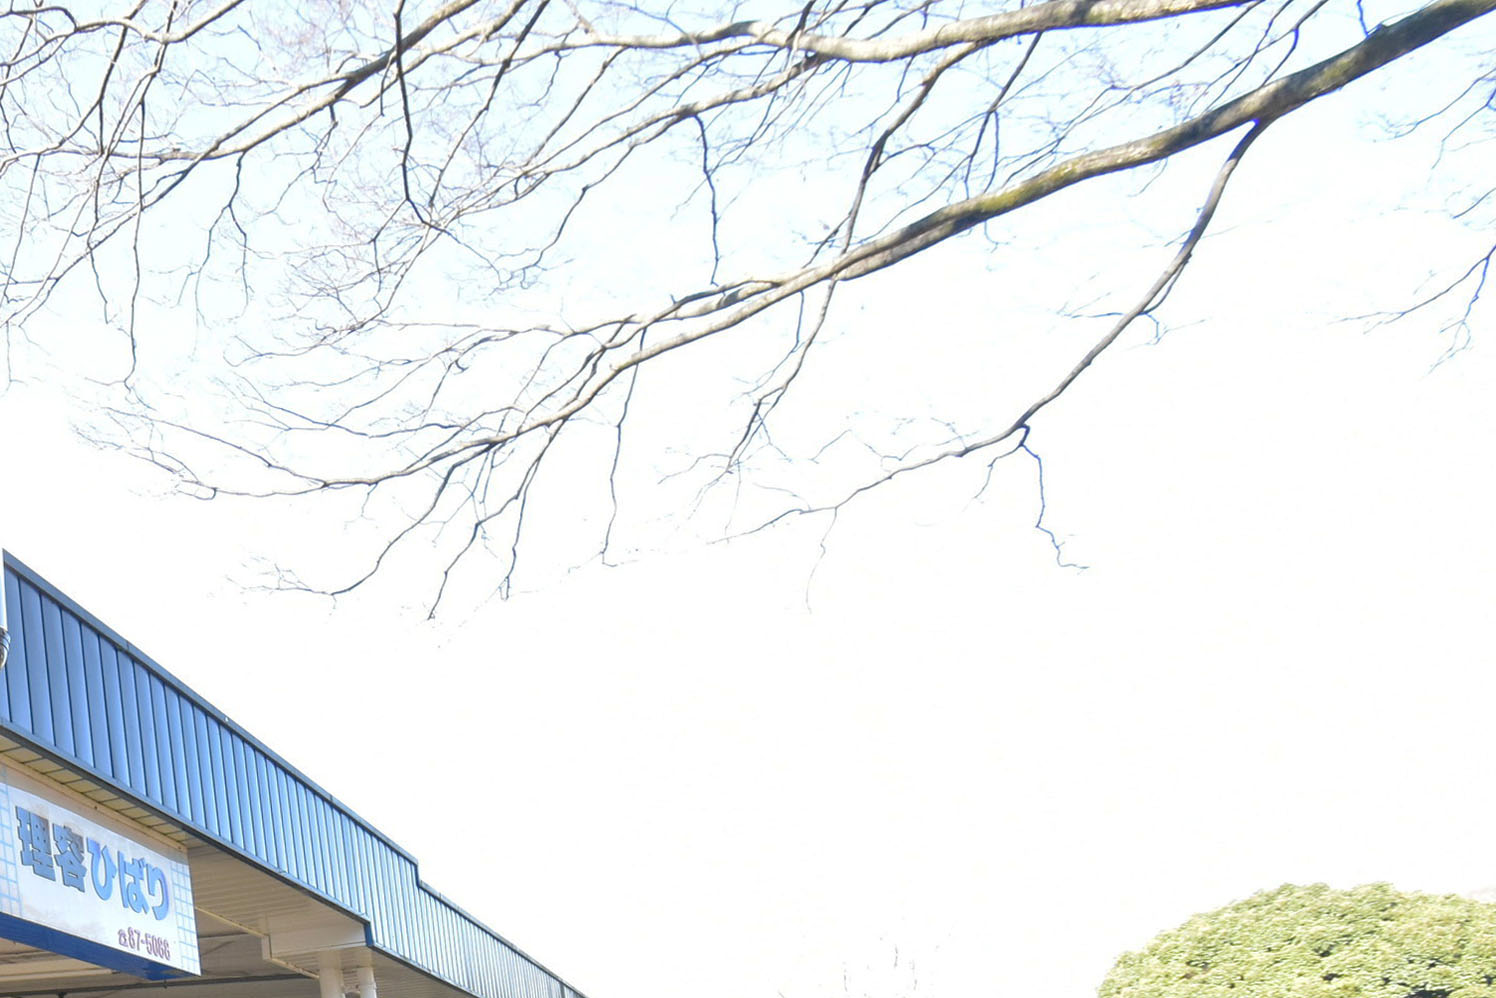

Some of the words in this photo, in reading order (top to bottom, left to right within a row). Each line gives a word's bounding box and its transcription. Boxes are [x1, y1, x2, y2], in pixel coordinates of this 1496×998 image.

[15, 806, 169, 921] 理容ひばり
